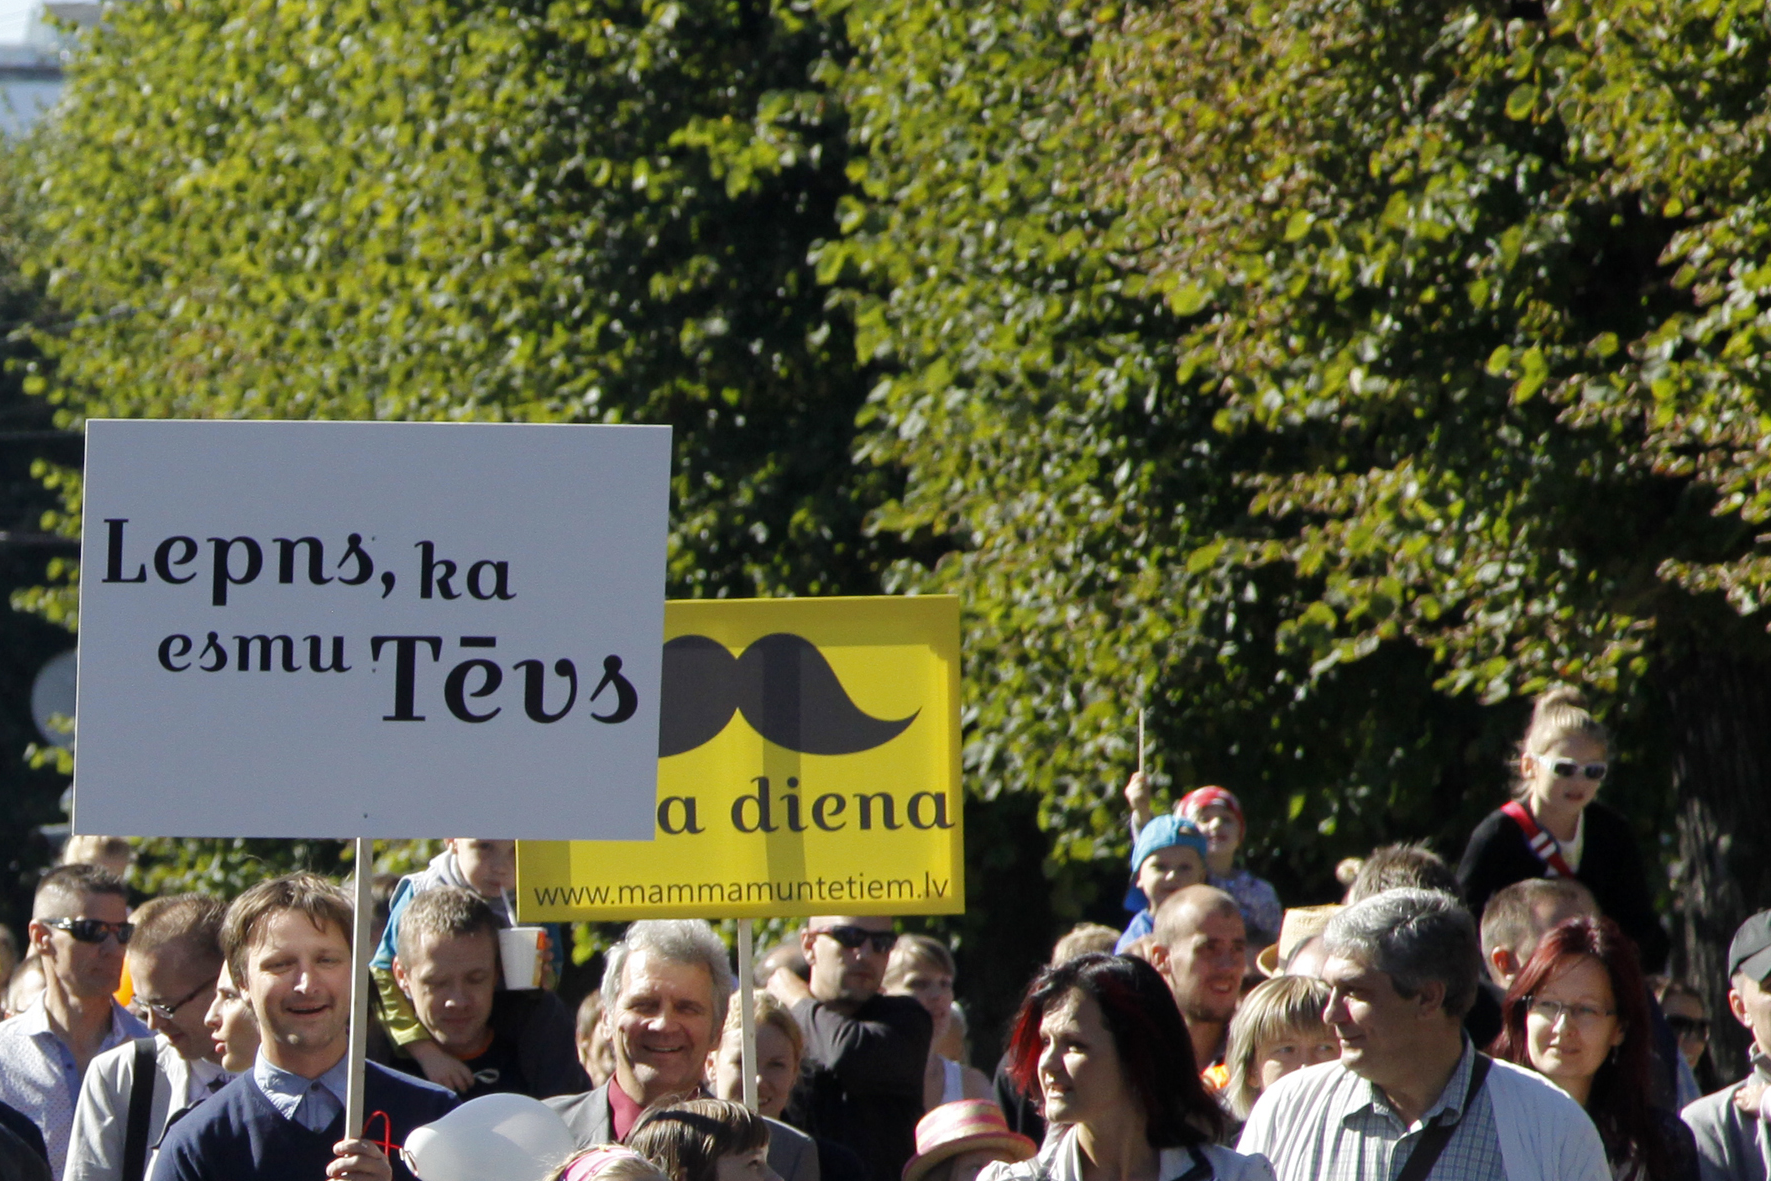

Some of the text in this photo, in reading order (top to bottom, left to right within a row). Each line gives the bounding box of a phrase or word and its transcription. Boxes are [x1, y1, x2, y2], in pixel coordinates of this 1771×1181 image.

[101, 518, 517, 606] Lepns, ka
[157, 630, 639, 725] esmu Tēvs
[730, 775, 956, 834] diena
[533, 871, 950, 907] www.mammamuntetiem.lv
